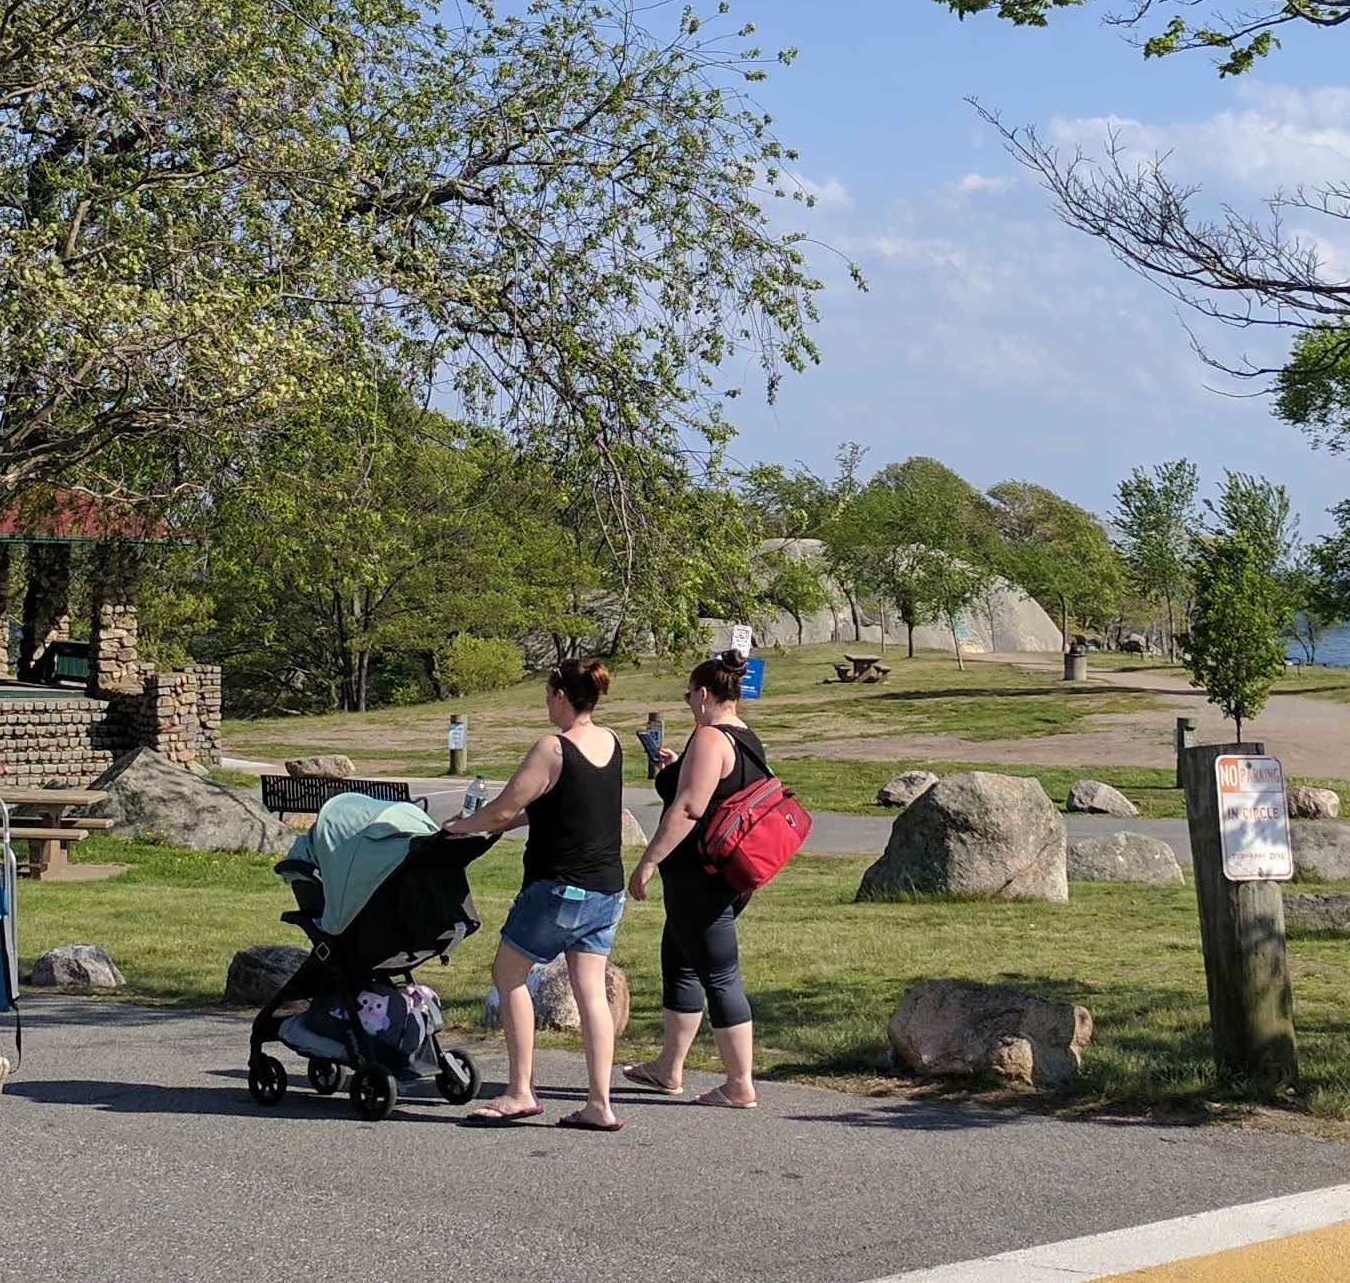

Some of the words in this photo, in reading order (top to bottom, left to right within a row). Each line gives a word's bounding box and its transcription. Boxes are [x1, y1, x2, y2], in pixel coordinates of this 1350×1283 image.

[1219, 764, 1238, 787] NO
[1239, 767, 1280, 784] PARKING
[1227, 807, 1238, 819] IN
[1243, 807, 1280, 820] CIRCLE
